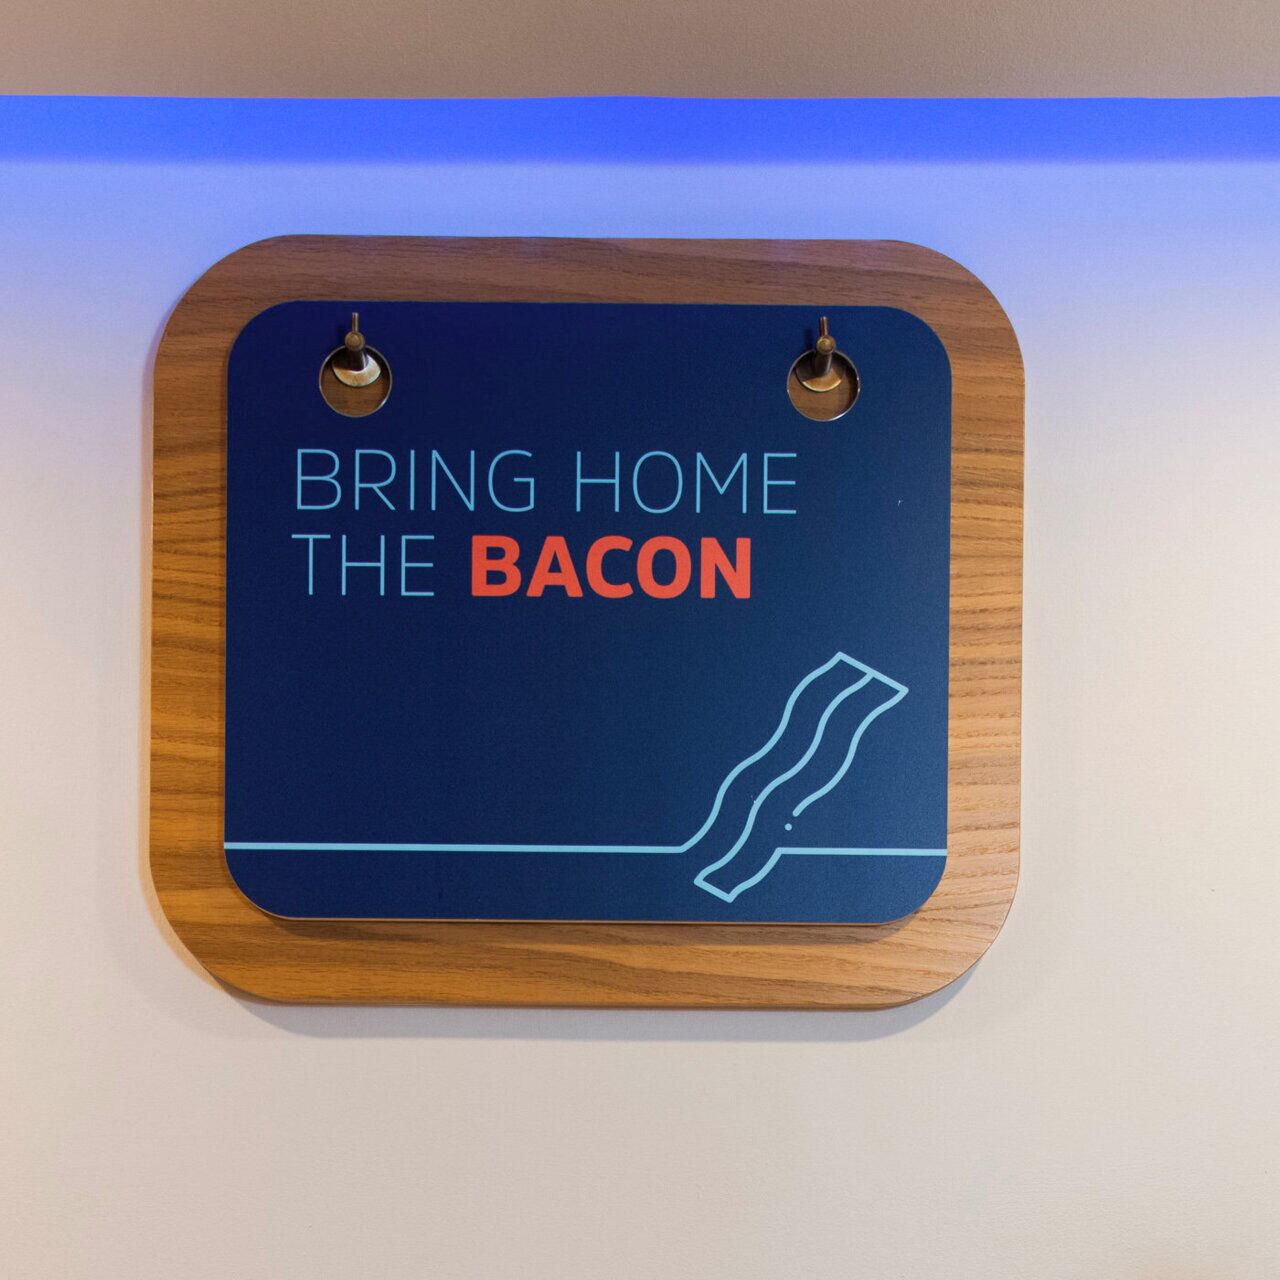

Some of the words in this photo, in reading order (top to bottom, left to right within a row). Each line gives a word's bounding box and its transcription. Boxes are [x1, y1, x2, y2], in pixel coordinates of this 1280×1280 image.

[294, 449, 536, 512] BRING
[575, 451, 798, 515] HOME
[291, 534, 435, 597] THE
[471, 534, 752, 599] BACON
